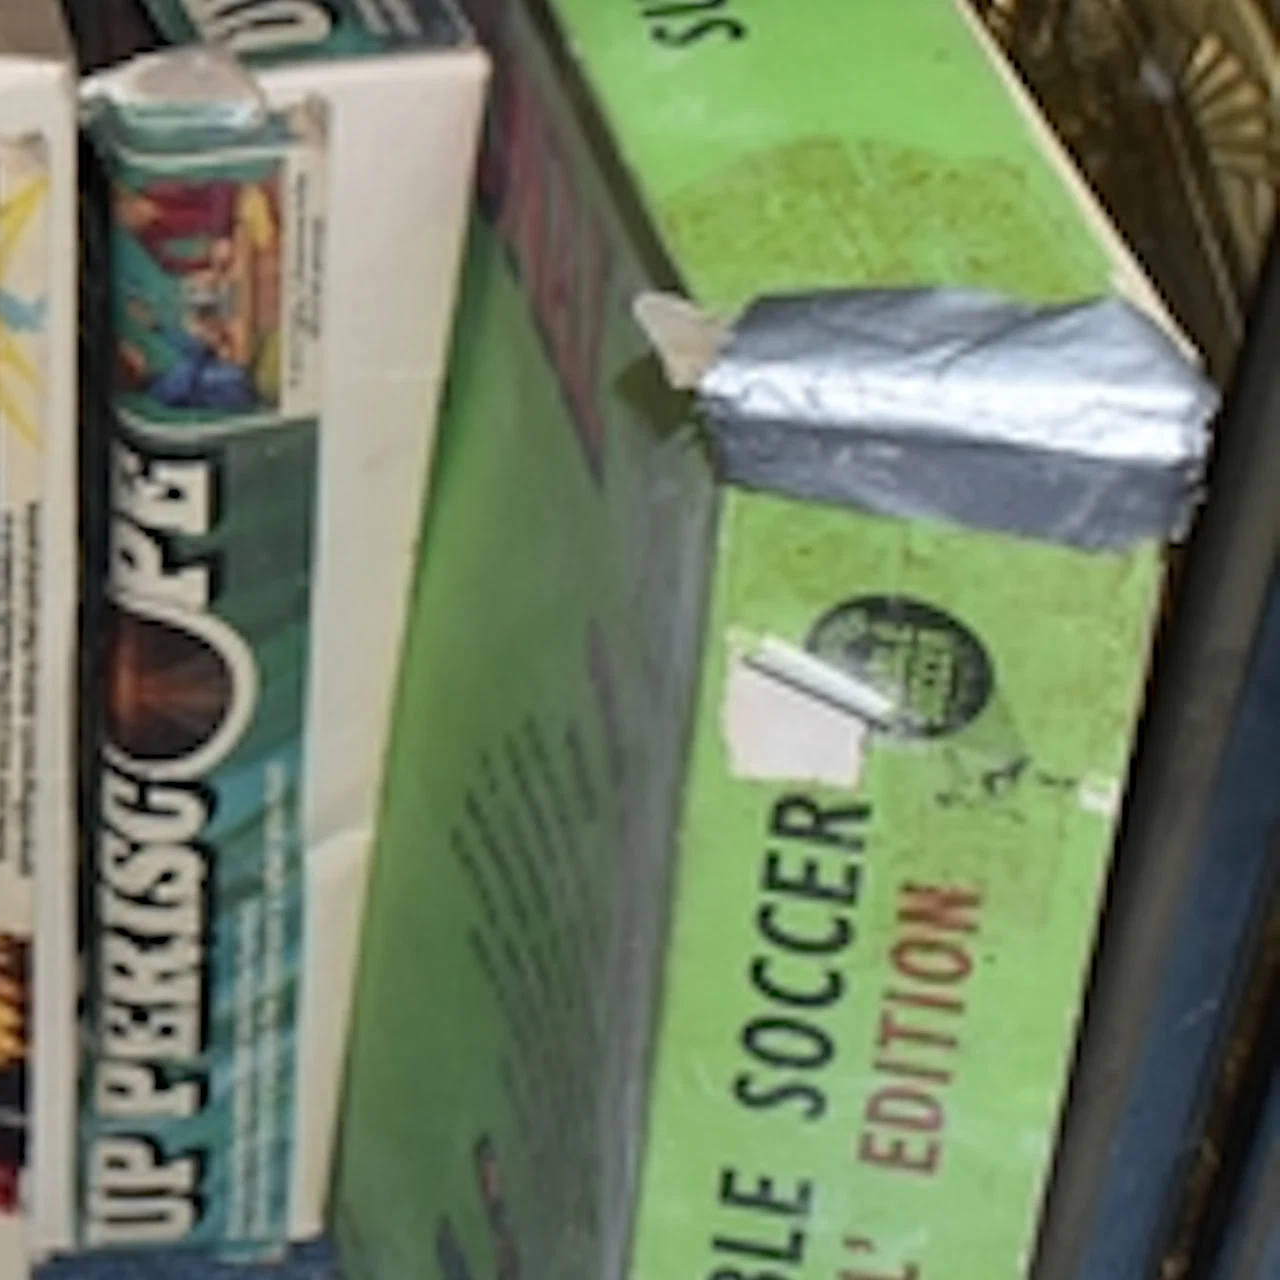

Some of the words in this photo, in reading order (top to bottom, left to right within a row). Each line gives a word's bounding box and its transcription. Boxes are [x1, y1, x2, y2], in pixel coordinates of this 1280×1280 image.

[735, 791, 873, 1121] SOCCER
[859, 881, 982, 1175] EDITION
[87, 1134, 201, 1243] UP
